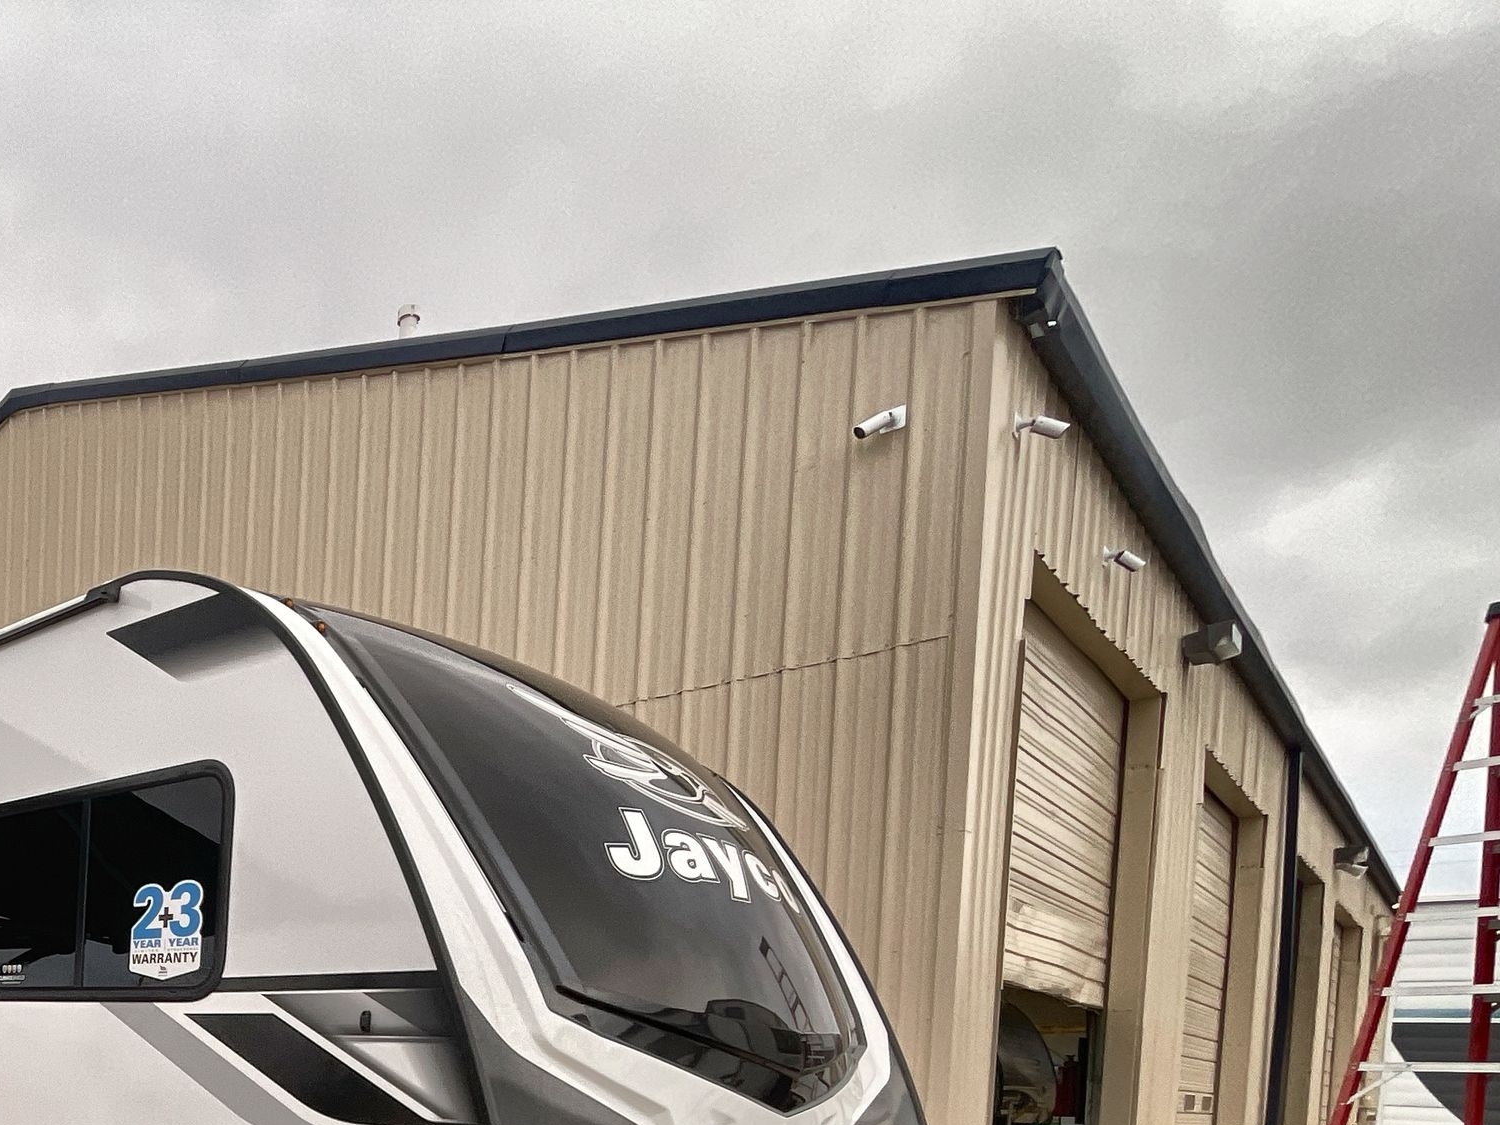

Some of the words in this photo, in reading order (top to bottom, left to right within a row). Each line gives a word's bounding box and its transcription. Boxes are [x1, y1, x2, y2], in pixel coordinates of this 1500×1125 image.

[133, 940, 161, 949] YEAR
[168, 937, 199, 947] YEAR
[132, 951, 198, 965] WARRANTY
